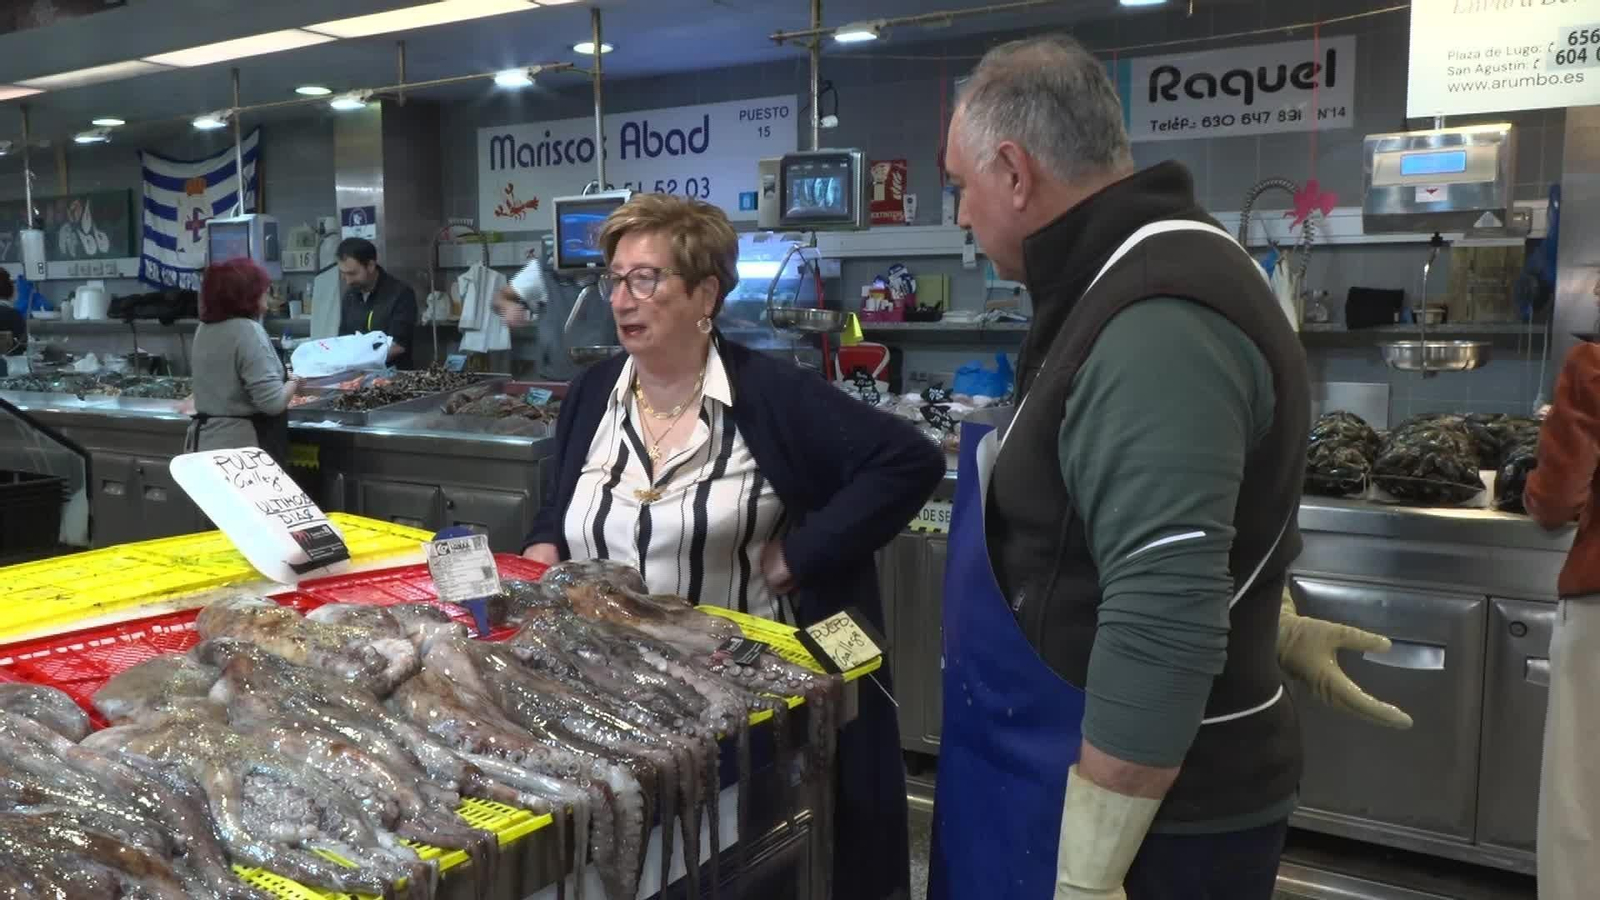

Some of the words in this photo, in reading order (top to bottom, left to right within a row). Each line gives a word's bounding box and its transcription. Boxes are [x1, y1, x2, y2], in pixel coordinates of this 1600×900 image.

[1447, 50, 1481, 61] Plaza
[1485, 49, 1501, 58] de
[1568, 28, 1600, 46] 656
[1447, 65, 1471, 77] San
[1555, 48, 1588, 65] 604
[1149, 48, 1337, 106] Raquel
[1447, 72, 1585, 93] www.arumbo.es
[739, 106, 789, 121] PUESTO
[1202, 114, 1236, 128] 630
[1241, 111, 1272, 126] 647
[620, 114, 710, 161] Abad
[758, 126, 771, 138] 15
[213, 450, 276, 475] PULPO
[923, 508, 936, 522] DE
